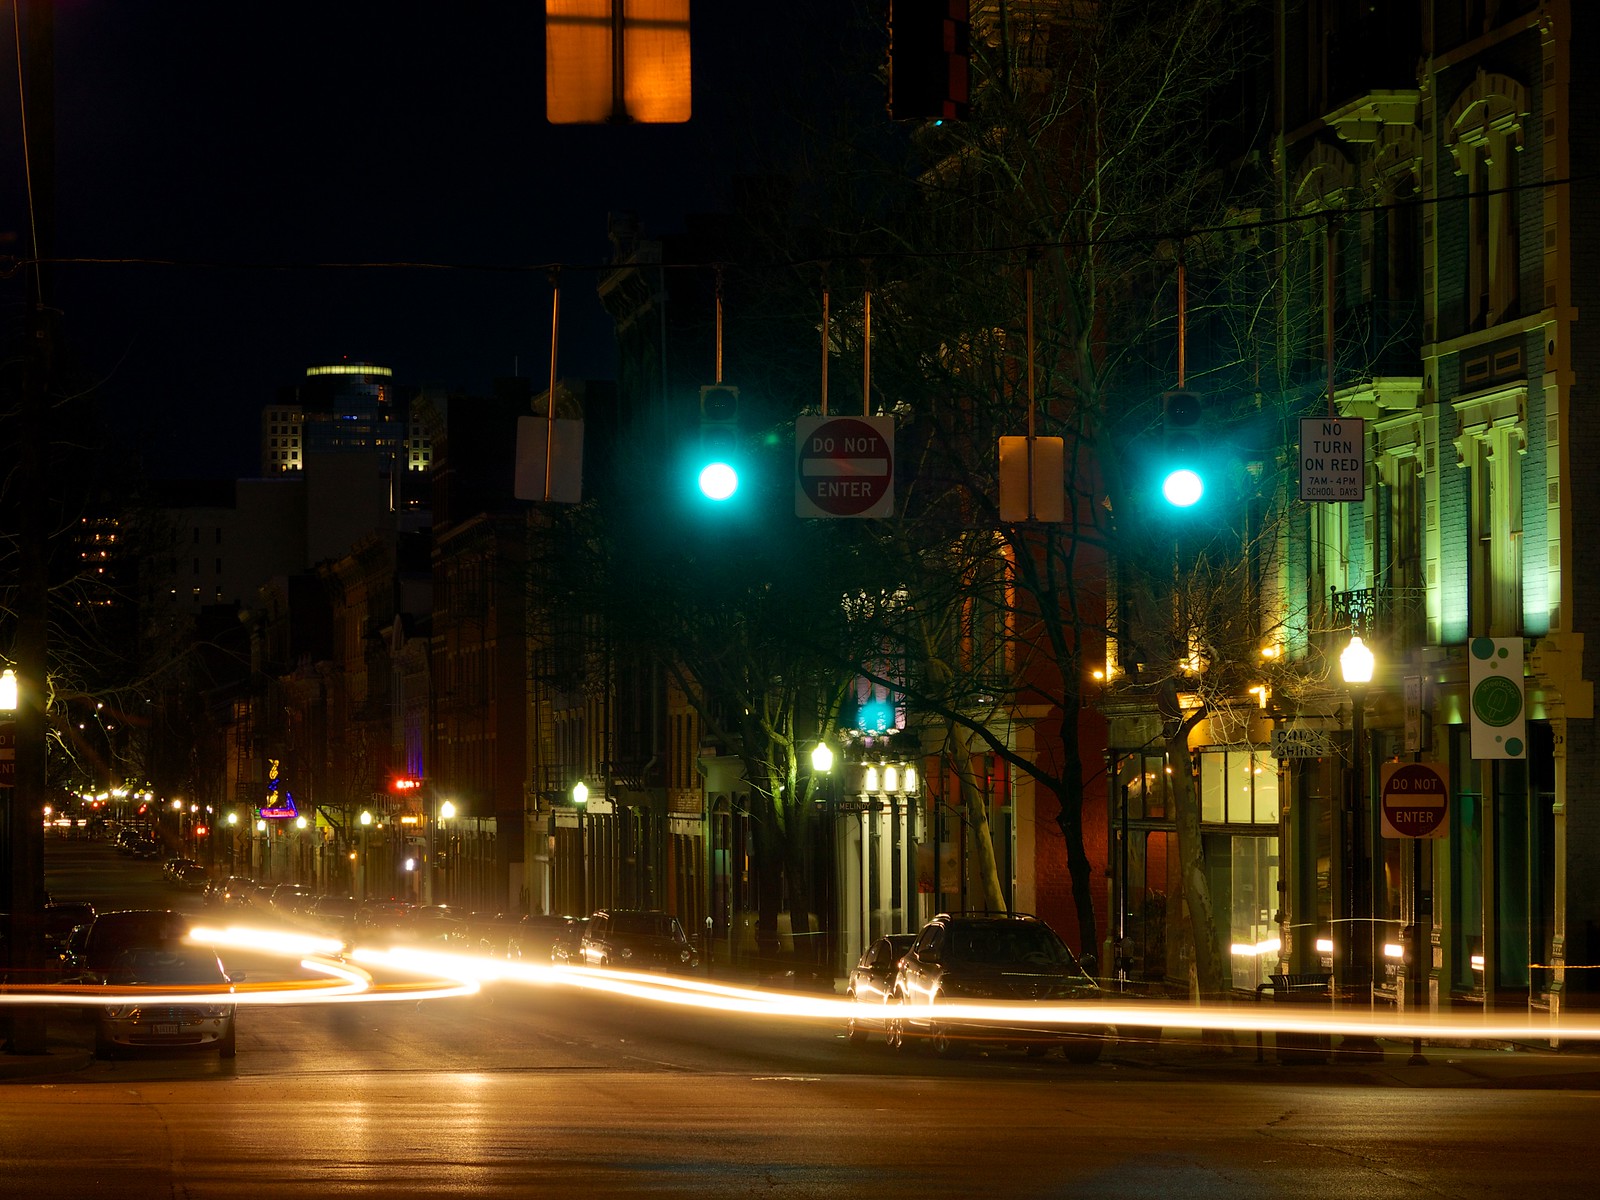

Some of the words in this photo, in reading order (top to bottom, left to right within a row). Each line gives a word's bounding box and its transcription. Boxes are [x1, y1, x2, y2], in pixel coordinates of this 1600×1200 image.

[1322, 423, 1342, 436] NO
[812, 437, 835, 453] DO
[844, 437, 878, 453] NOT
[1313, 441, 1352, 454] TURN
[1305, 458, 1324, 471] ON
[1331, 458, 1359, 471] RED
[1309, 477, 1328, 485] 7AM
[1335, 477, 1356, 485] 4PM
[817, 482, 872, 497] ENTER
[1306, 487, 1336, 496] SCHOOL
[1339, 487, 1358, 496] DAYS
[1277, 745, 1324, 757] SHIRTS
[1392, 778, 1408, 790] DO
[1414, 778, 1438, 790] NOT
[839, 802, 871, 810] MELINDY
[1396, 811, 1434, 823] ENTER
